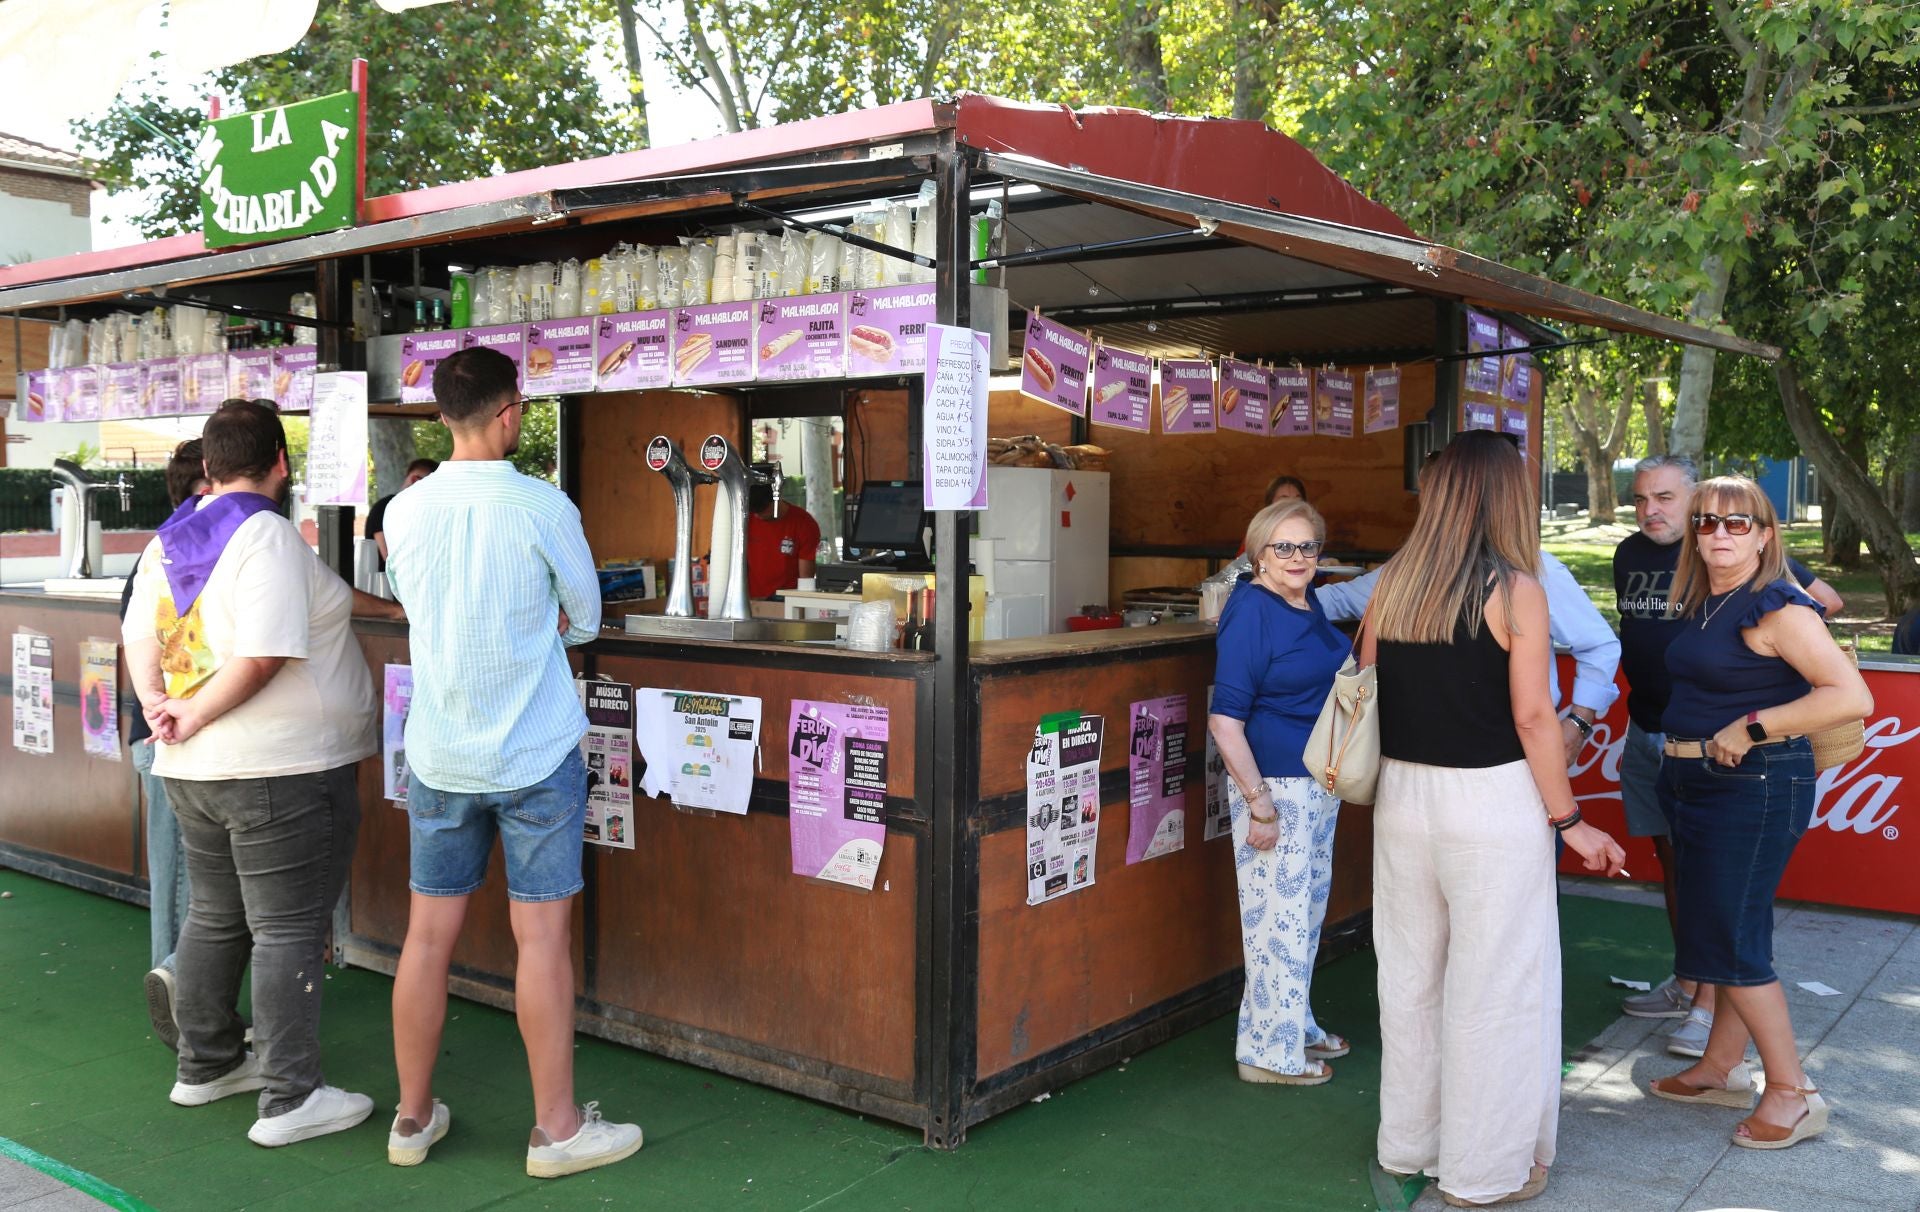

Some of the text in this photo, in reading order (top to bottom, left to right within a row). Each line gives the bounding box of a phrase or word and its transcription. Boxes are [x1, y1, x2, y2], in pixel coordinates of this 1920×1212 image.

[250, 107, 293, 153] LA
[873, 292, 936, 310] MALHABLADA
[781, 302, 839, 318] MALHABLADA
[695, 310, 749, 326] MALHABLADA
[544, 325, 590, 339] MALHABLADA
[616, 318, 666, 333] MALHABLADA
[810, 320, 834, 331] FAJITA
[900, 323, 926, 335] PERRI
[637, 335, 666, 345] MUU RICA
[716, 338, 749, 348] SANDWICH
[1045, 329, 1088, 358] MALHABLADA
[900, 358, 925, 367] TAPA 3,0
[937, 359, 971, 369] REFRESCO
[1112, 357, 1150, 375] MALHABLADA
[937, 371, 954, 381] CAÑA
[1060, 363, 1084, 381] PERRITO
[1175, 368, 1211, 379] MALHABLADA
[1233, 369, 1266, 385] MALHABLADA
[936, 412, 955, 421] AGUA
[937, 426, 952, 435] VINO
[936, 439, 956, 448] SIDRA
[936, 452, 974, 462] CALIMOCHO
[936, 466, 952, 474] TAPA
[935, 479, 960, 488] BEBIDA
[1637, 598, 1649, 610] del
[1651, 598, 1683, 611] Hiero
[595, 684, 623, 699] MÚSICA
[589, 697, 629, 711] EN DIRECTO
[685, 715, 696, 725] San
[797, 718, 827, 736] FERIA
[1062, 732, 1098, 749] EN DIRECTO
[800, 735, 827, 763] DÍA
